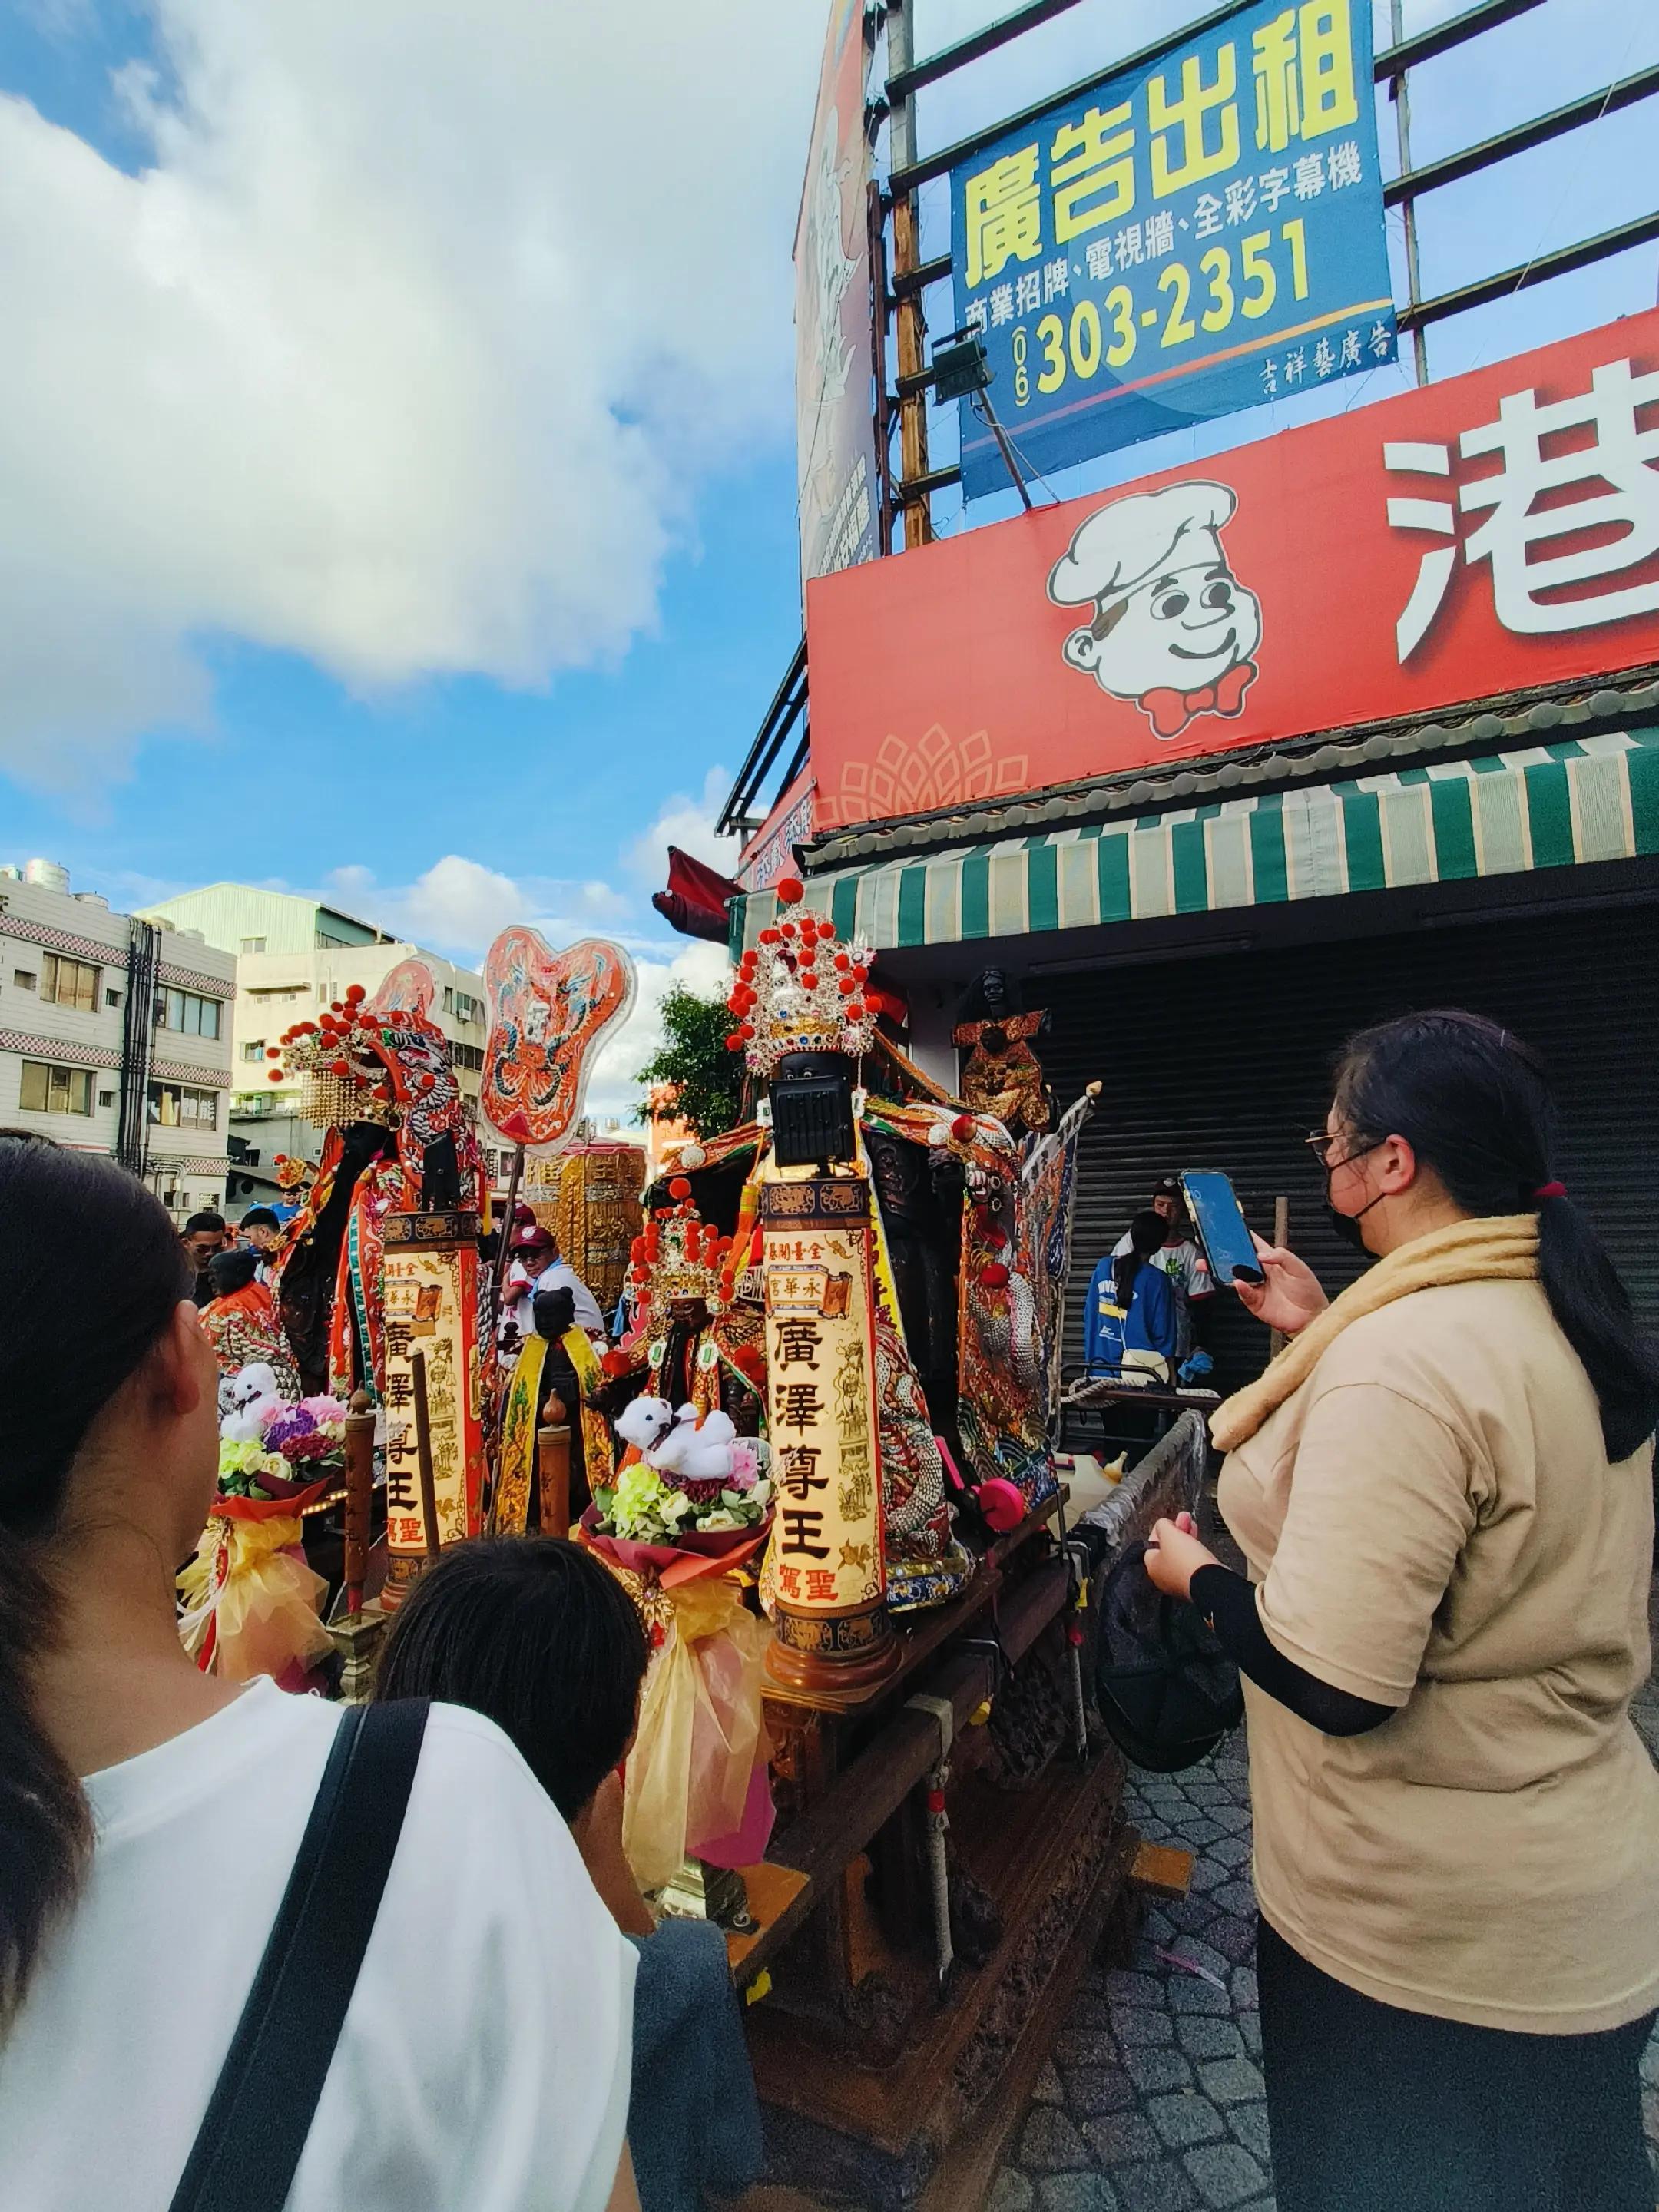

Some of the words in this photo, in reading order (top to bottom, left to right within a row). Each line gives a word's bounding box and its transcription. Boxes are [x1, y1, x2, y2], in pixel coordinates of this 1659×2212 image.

[965, 0, 1359, 289] 廣告出租
[1035, 218, 1309, 394] 303-2351
[1259, 320, 1391, 394] 吉祥藝廣告
[1383, 357, 1659, 664] 港
[775, 1317, 830, 1559] 廣澤尊王
